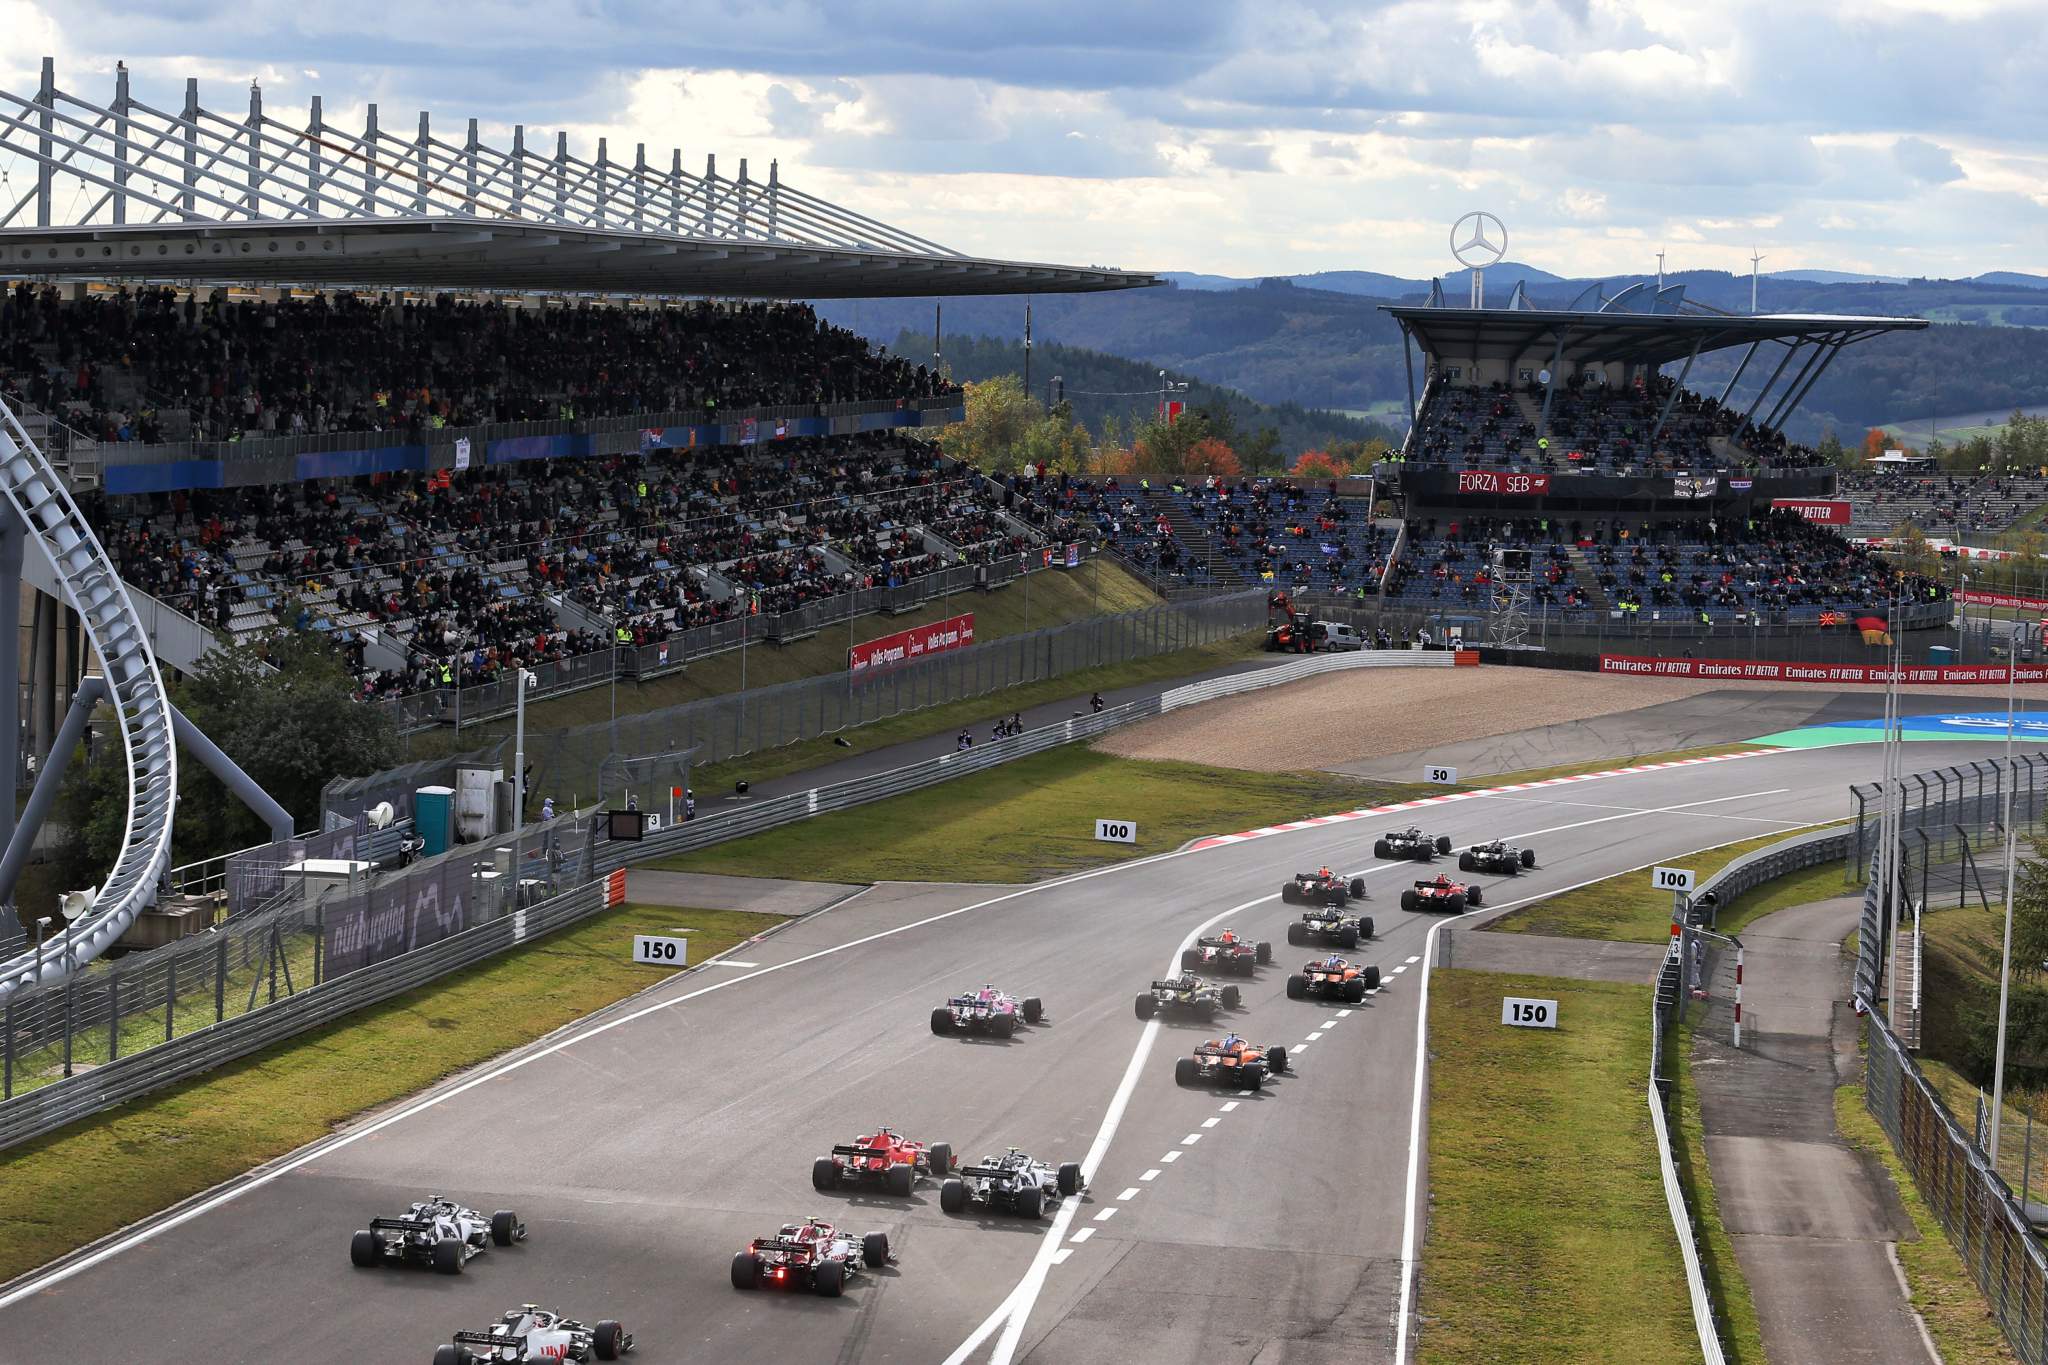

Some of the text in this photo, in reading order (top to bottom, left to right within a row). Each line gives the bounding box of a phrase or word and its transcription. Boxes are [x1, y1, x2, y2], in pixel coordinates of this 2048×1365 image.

[1459, 474, 1529, 492] FORZA SEB
[1804, 506, 1831, 519] BETTER
[1604, 658, 1692, 673] Emirates FLY BETTER
[1699, 663, 1779, 677] Emirates FLY BETTER
[1785, 666, 1863, 680] Emirates FLY BETTER
[1909, 670, 1919, 680] FLY
[1919, 669, 1938, 681] BETTER
[1943, 668, 2006, 680] Emirates FLY BETTER
[2011, 669, 2043, 679] Emirates
[1432, 769, 1447, 781] 50
[651, 815, 658, 825] 3
[1101, 823, 1128, 839] 100
[1660, 871, 1687, 887] 100
[643, 941, 677, 960] 150
[1673, 943, 1679, 954] 3
[1513, 1004, 1547, 1023] 150
